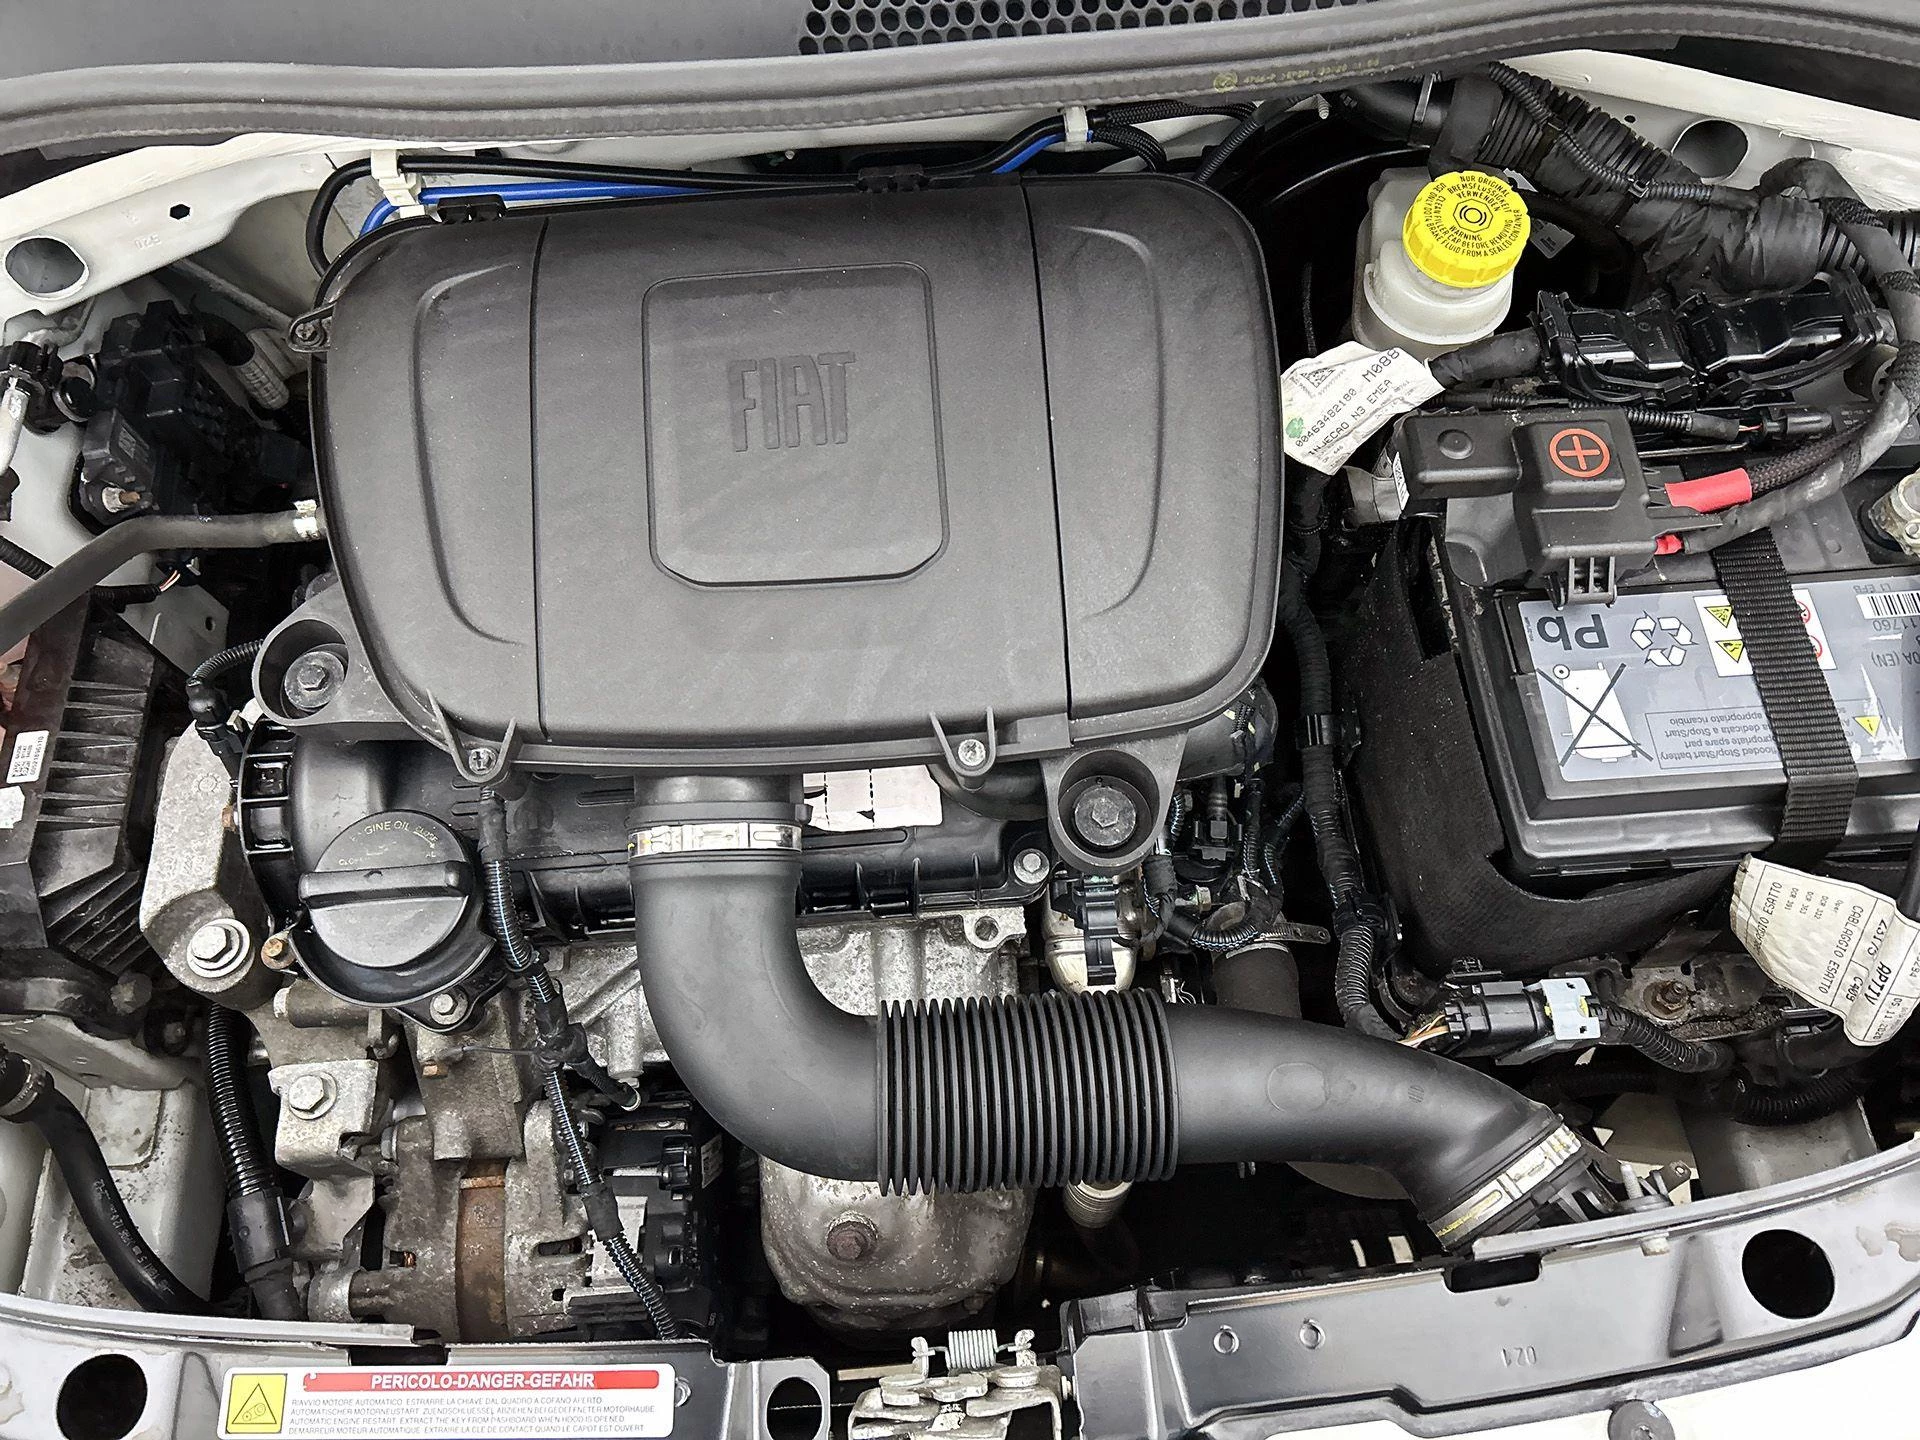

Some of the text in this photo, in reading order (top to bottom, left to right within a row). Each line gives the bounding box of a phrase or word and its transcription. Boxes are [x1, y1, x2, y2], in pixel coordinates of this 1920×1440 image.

[1433, 182, 1447, 193] USE
[1478, 177, 1510, 197] ORIGINAL
[1425, 192, 1438, 206] ONLY
[1456, 190, 1501, 211] VERWENDEN
[1433, 195, 1513, 249] CLEAN FILLER CAP BEFORE REMOVING
[1508, 209, 1522, 241] CONTAINER
[1426, 222, 1444, 242] BRAKE
[1449, 225, 1483, 241] WARNING
[1441, 239, 1461, 254] FLUID
[1461, 248, 1482, 257] FROM
[1489, 239, 1512, 256] SEALED
[727, 351, 856, 453] FIAT
[1295, 388, 1358, 448] 00463482180
[1361, 349, 1400, 383] M088
[1308, 421, 1350, 456] INJECAO
[1351, 405, 1366, 422] N3
[1366, 379, 1393, 405] EMEA
[1853, 583, 1877, 594] EFB
[1536, 613, 1609, 650] Pb
[1871, 650, 1900, 667] (EN)
[1670, 711, 1763, 727] appropriato ricambio
[1665, 727, 1711, 738] Stop/Start
[1721, 723, 1760, 733] dedicata
[1684, 739, 1702, 749] part
[1705, 737, 1730, 746] spare
[1660, 751, 1693, 761] battery
[1693, 748, 1740, 760] Stop/Start
[393, 820, 411, 832] OIL
[1762, 881, 1783, 915] ESATTO
[1818, 905, 1864, 994] CABLAGGIO ESATTO
[1864, 961, 1892, 1006] APTIV
[371, 1372, 596, 1389] PERICOLO-DANGER-GEFAHR
[355, 1398, 403, 1406] AUTOMATICO
[501, 1397, 533, 1405] QUADRO
[290, 1405, 655, 1416] AUTOMATISCHER MOTORNEUSTART ZUENDSCHLUESSEL ABZIEHEN BEI GEOEFFNETER MOTORHAUBE
[289, 1415, 625, 1425] AUTOMATIC ENGINE RESTART EXTRACT THE KEY FROM DASHBOARD WHEN HOOD IS OPENED
[288, 1427, 335, 1435] DEMARREUR
[336, 1427, 368, 1435] MOTEUR
[369, 1426, 420, 1435] AUTOMATIQUE
[424, 1426, 459, 1434] EXTRAIRE
[461, 1426, 470, 1434] LA
[499, 1425, 533, 1433] CONTACT
[534, 1425, 561, 1433] QUAND
[599, 1424, 612, 1432] EST
[614, 1424, 644, 1432] OUVERT
